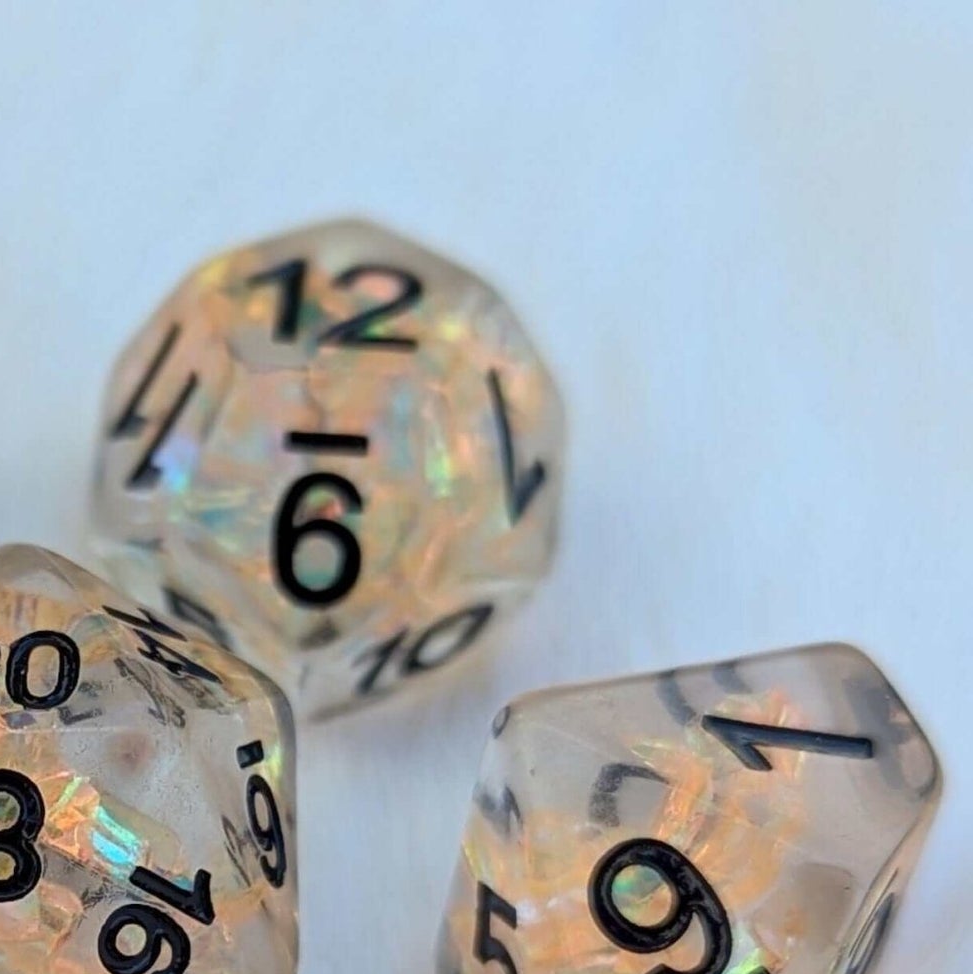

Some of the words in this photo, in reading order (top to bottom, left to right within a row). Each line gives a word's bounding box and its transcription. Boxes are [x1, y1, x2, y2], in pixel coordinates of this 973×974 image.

[244, 259, 424, 350] 12
[355, 603, 494, 695] 10
[702, 714, 874, 772] 1
